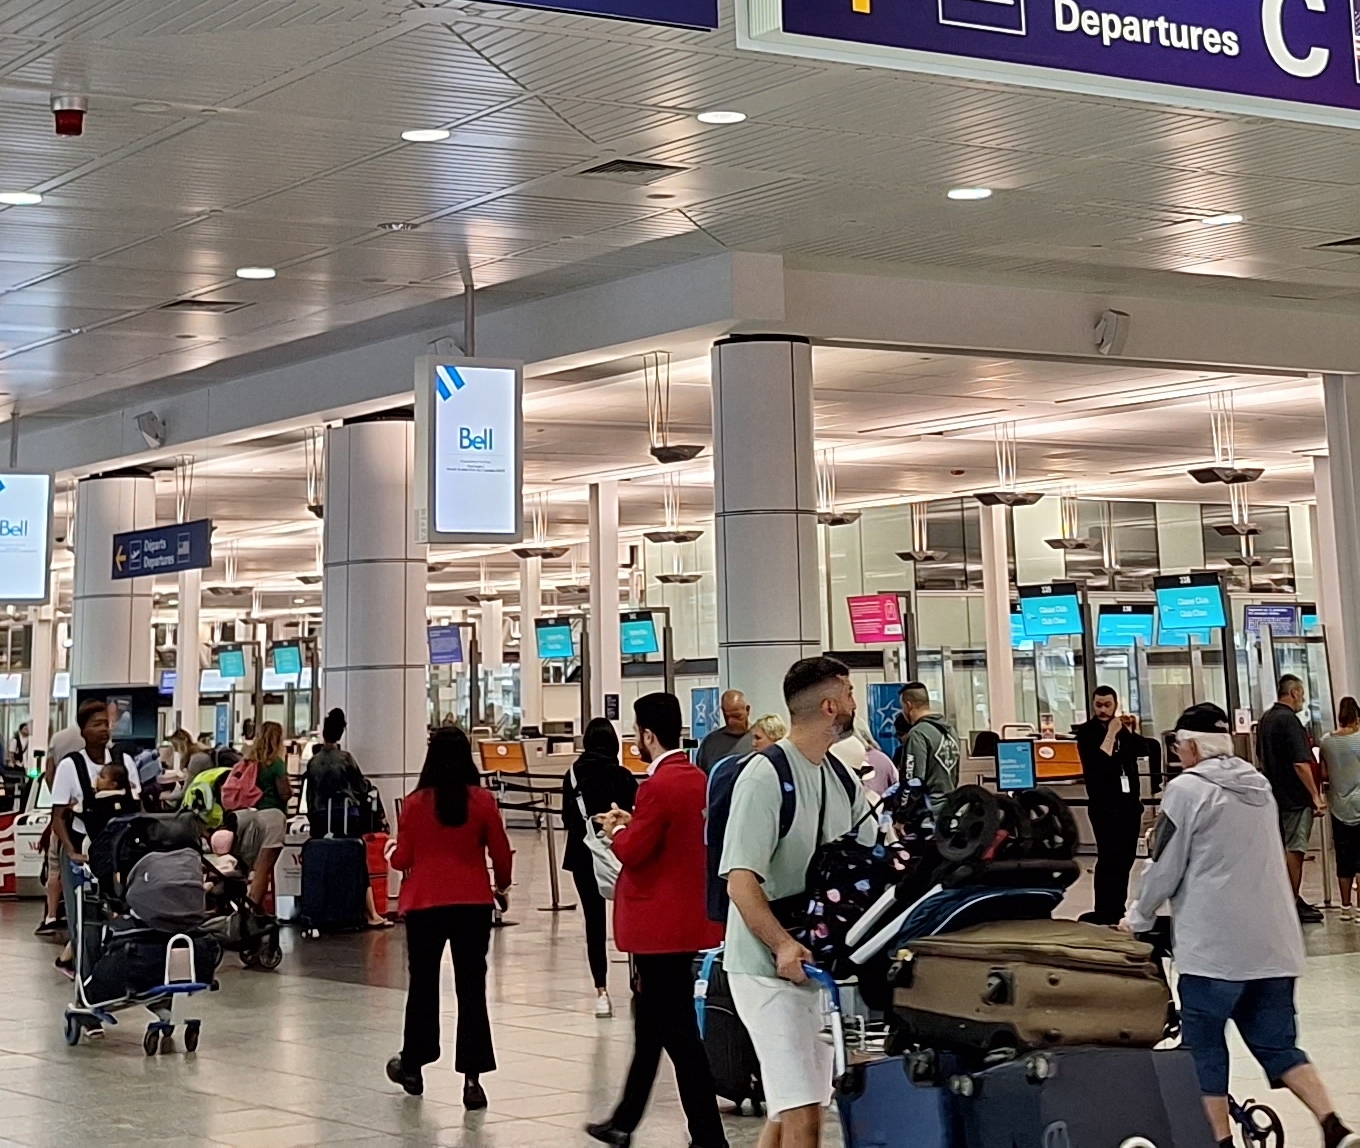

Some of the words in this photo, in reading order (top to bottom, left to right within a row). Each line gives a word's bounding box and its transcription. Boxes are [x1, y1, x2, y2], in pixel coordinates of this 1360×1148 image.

[459, 427, 493, 451] Bell
[0, 519, 28, 537] Bell
[143, 554, 175, 570] Departures
